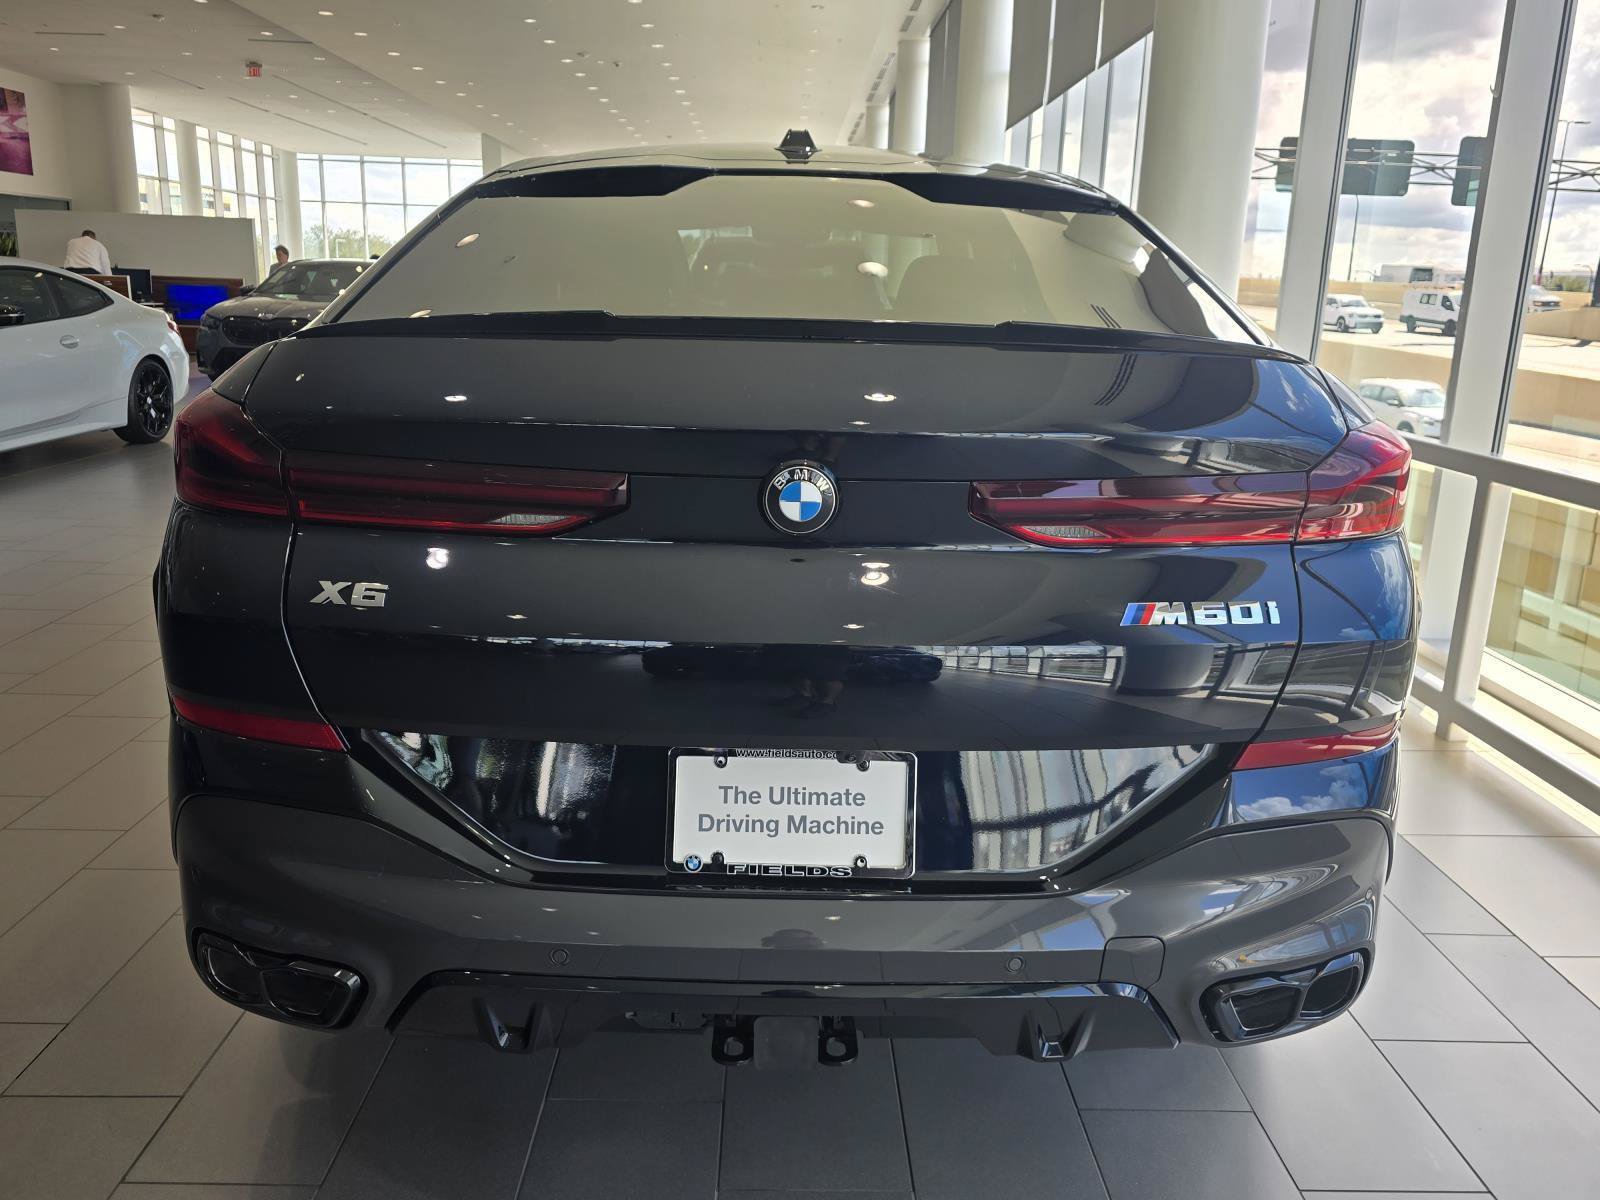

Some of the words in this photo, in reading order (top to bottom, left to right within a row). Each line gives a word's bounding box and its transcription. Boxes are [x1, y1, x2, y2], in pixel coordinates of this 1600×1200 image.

[773, 469, 833, 496] BMW
[309, 580, 390, 607] X6
[1149, 600, 1281, 626] M60i
[735, 748, 838, 760] www.fieldsauto.co
[718, 785, 762, 805] The
[768, 786, 866, 807] Ultimate
[697, 813, 780, 838] Driving
[786, 814, 884, 835] Machine
[726, 863, 853, 877] FIELDS
